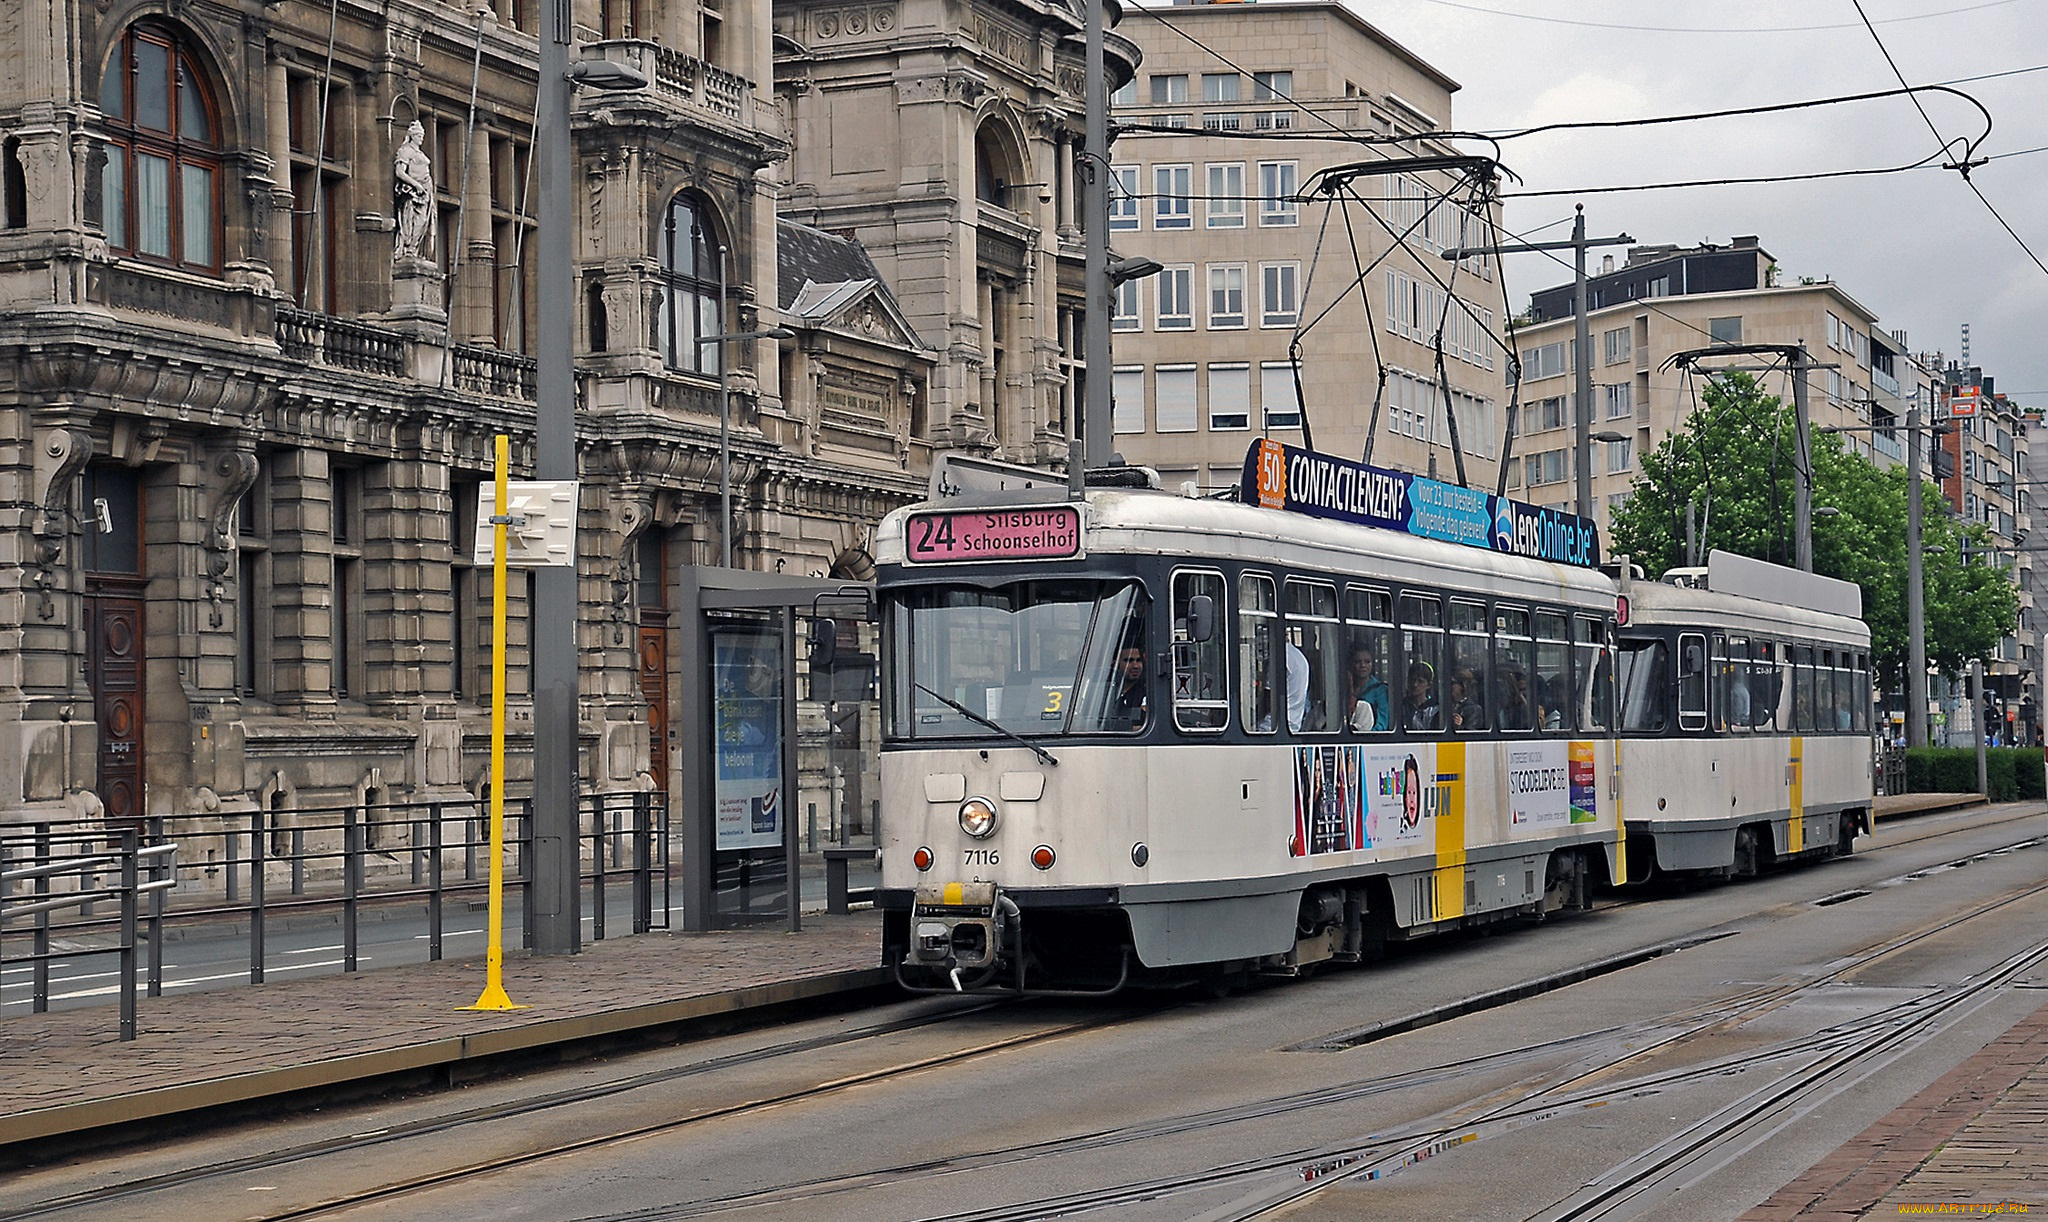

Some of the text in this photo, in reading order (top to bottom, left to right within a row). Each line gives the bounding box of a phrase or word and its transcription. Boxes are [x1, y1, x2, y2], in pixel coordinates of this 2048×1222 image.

[1264, 452, 1280, 493] 50
[1290, 454, 1405, 521] CONTACTLENZEN?
[1417, 480, 1433, 504] Voor
[1434, 484, 1442, 506] 23
[1455, 486, 1477, 513] besteld
[917, 516, 956, 552] 24
[986, 512, 1067, 529] Silsburg
[1416, 505, 1446, 535] Volgende
[1447, 511, 1459, 541] dag
[963, 529, 1075, 551] Schoonselhof
[723, 678, 735, 693] De
[1044, 691, 1063, 713] 3
[964, 850, 1000, 865] 7116
